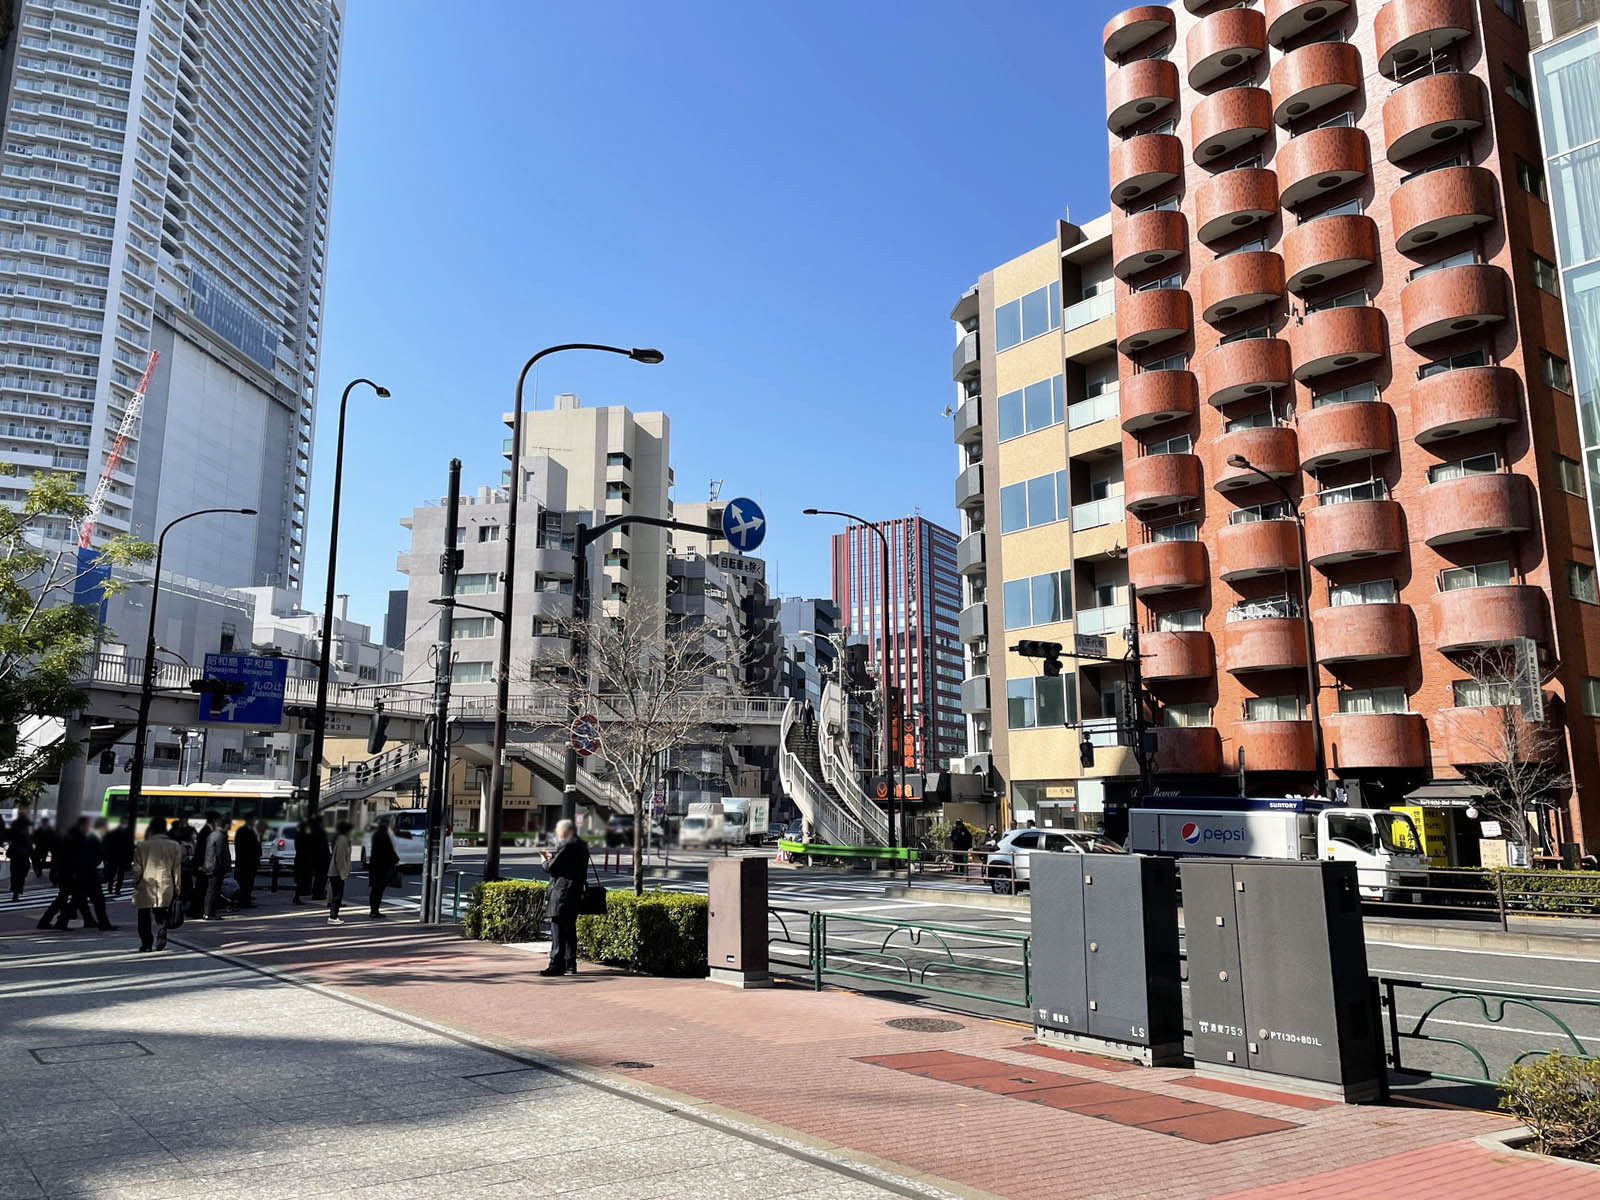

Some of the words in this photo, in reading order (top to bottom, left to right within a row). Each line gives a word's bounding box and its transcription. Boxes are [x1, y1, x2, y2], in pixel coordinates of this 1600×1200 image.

[720, 557, 761, 575] 自転車を除く
[207, 655, 239, 667] 昭和島
[243, 658, 274, 669] 平和島
[1203, 827, 1246, 844] pepsi
[1131, 1026, 1145, 1038] LS
